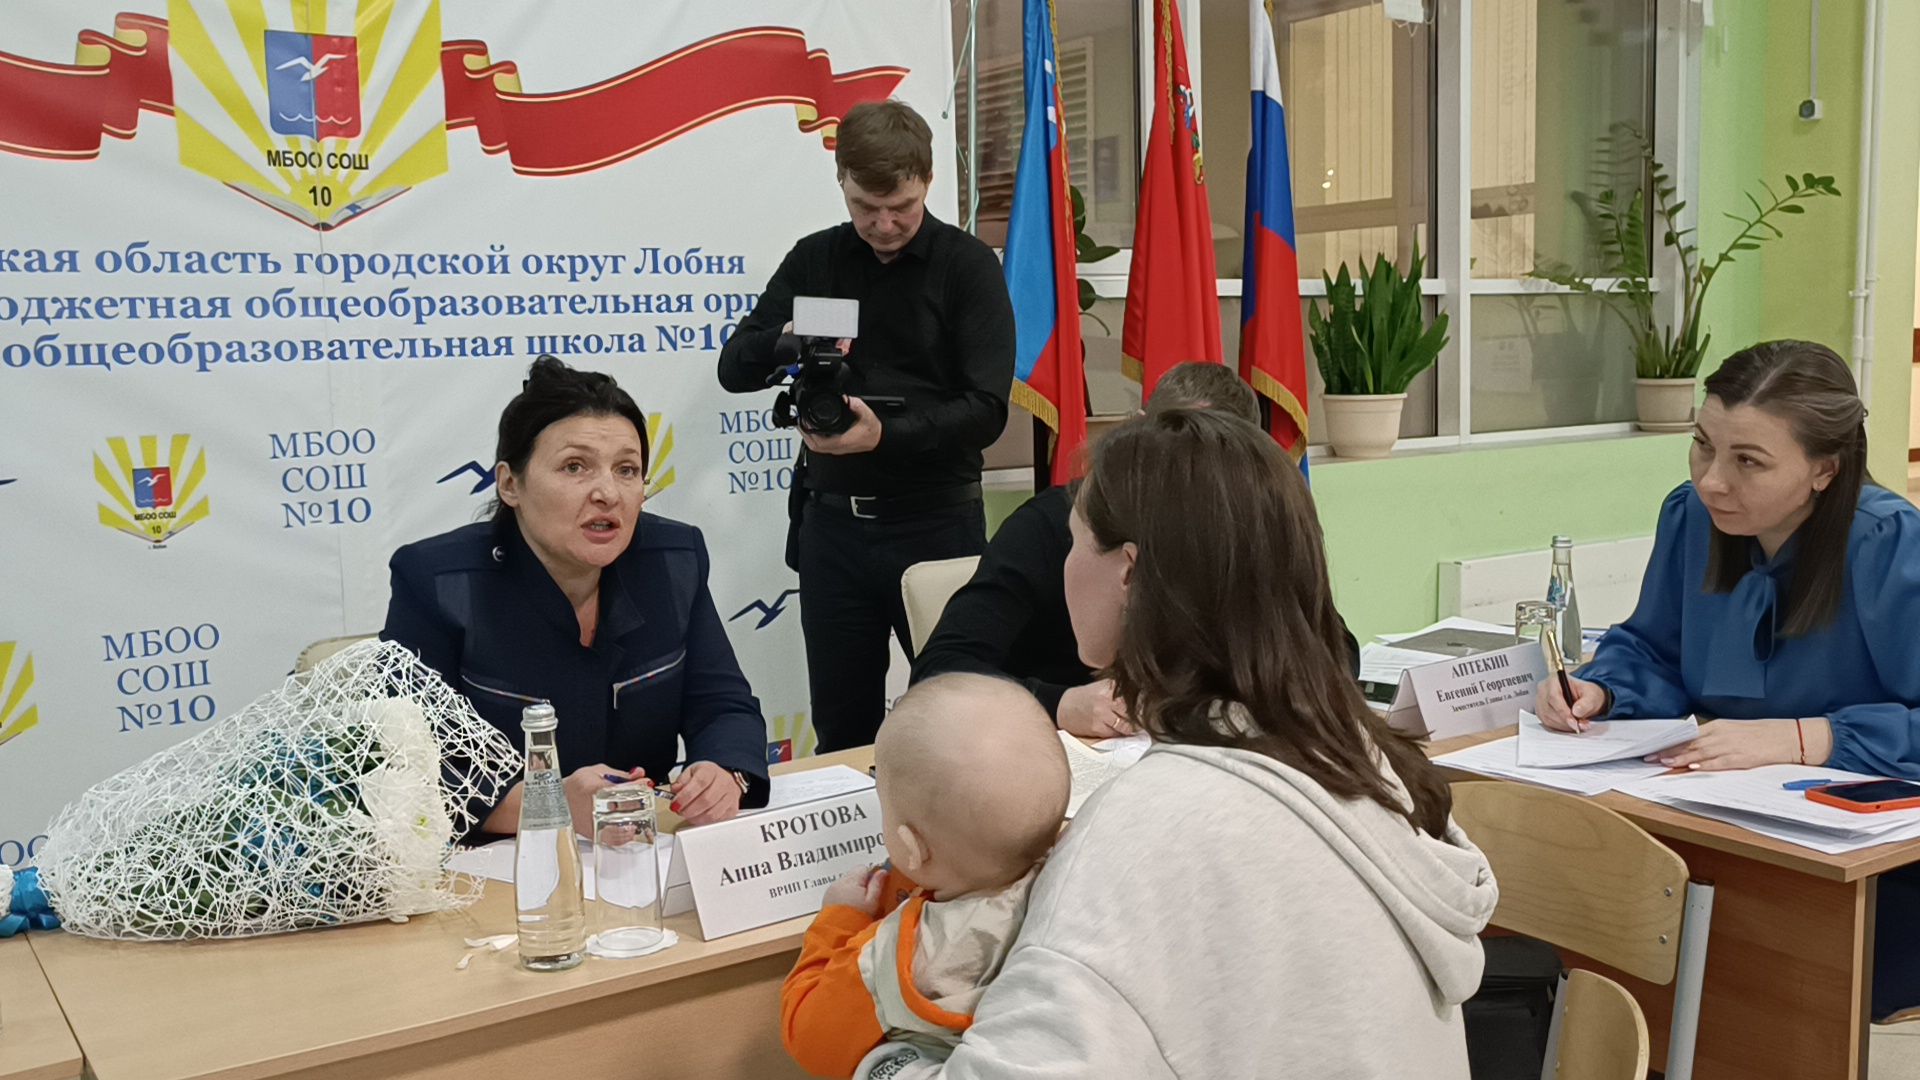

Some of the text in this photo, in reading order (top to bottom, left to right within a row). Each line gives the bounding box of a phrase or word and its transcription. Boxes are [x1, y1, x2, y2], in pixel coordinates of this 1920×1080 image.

[267, 149, 370, 170] МБОО СОШ
[308, 185, 333, 207] 10
[94, 240, 282, 275] область
[294, 244, 510, 283] городской
[521, 249, 627, 282] округ
[634, 246, 745, 275] Лобня
[245, 286, 694, 325] общеобразовательная
[2, 331, 514, 373] общеобразовательная
[525, 333, 647, 356] школа
[268, 427, 376, 460] МБОО
[728, 437, 792, 464] СОШ
[281, 463, 368, 493] СОШ
[728, 466, 794, 495] №10
[280, 496, 372, 529] №10
[152, 525, 162, 534] 10
[101, 622, 220, 662] МБОО
[116, 659, 212, 696] СОШ
[1451, 653, 1510, 679] АПТЕКИН
[1436, 672, 1535, 703] Евгений Георгиевич
[116, 694, 216, 733] №10
[760, 802, 868, 844] КРОТОВА
[719, 860, 773, 888] Анна
[777, 831, 886, 872] Владимиро
